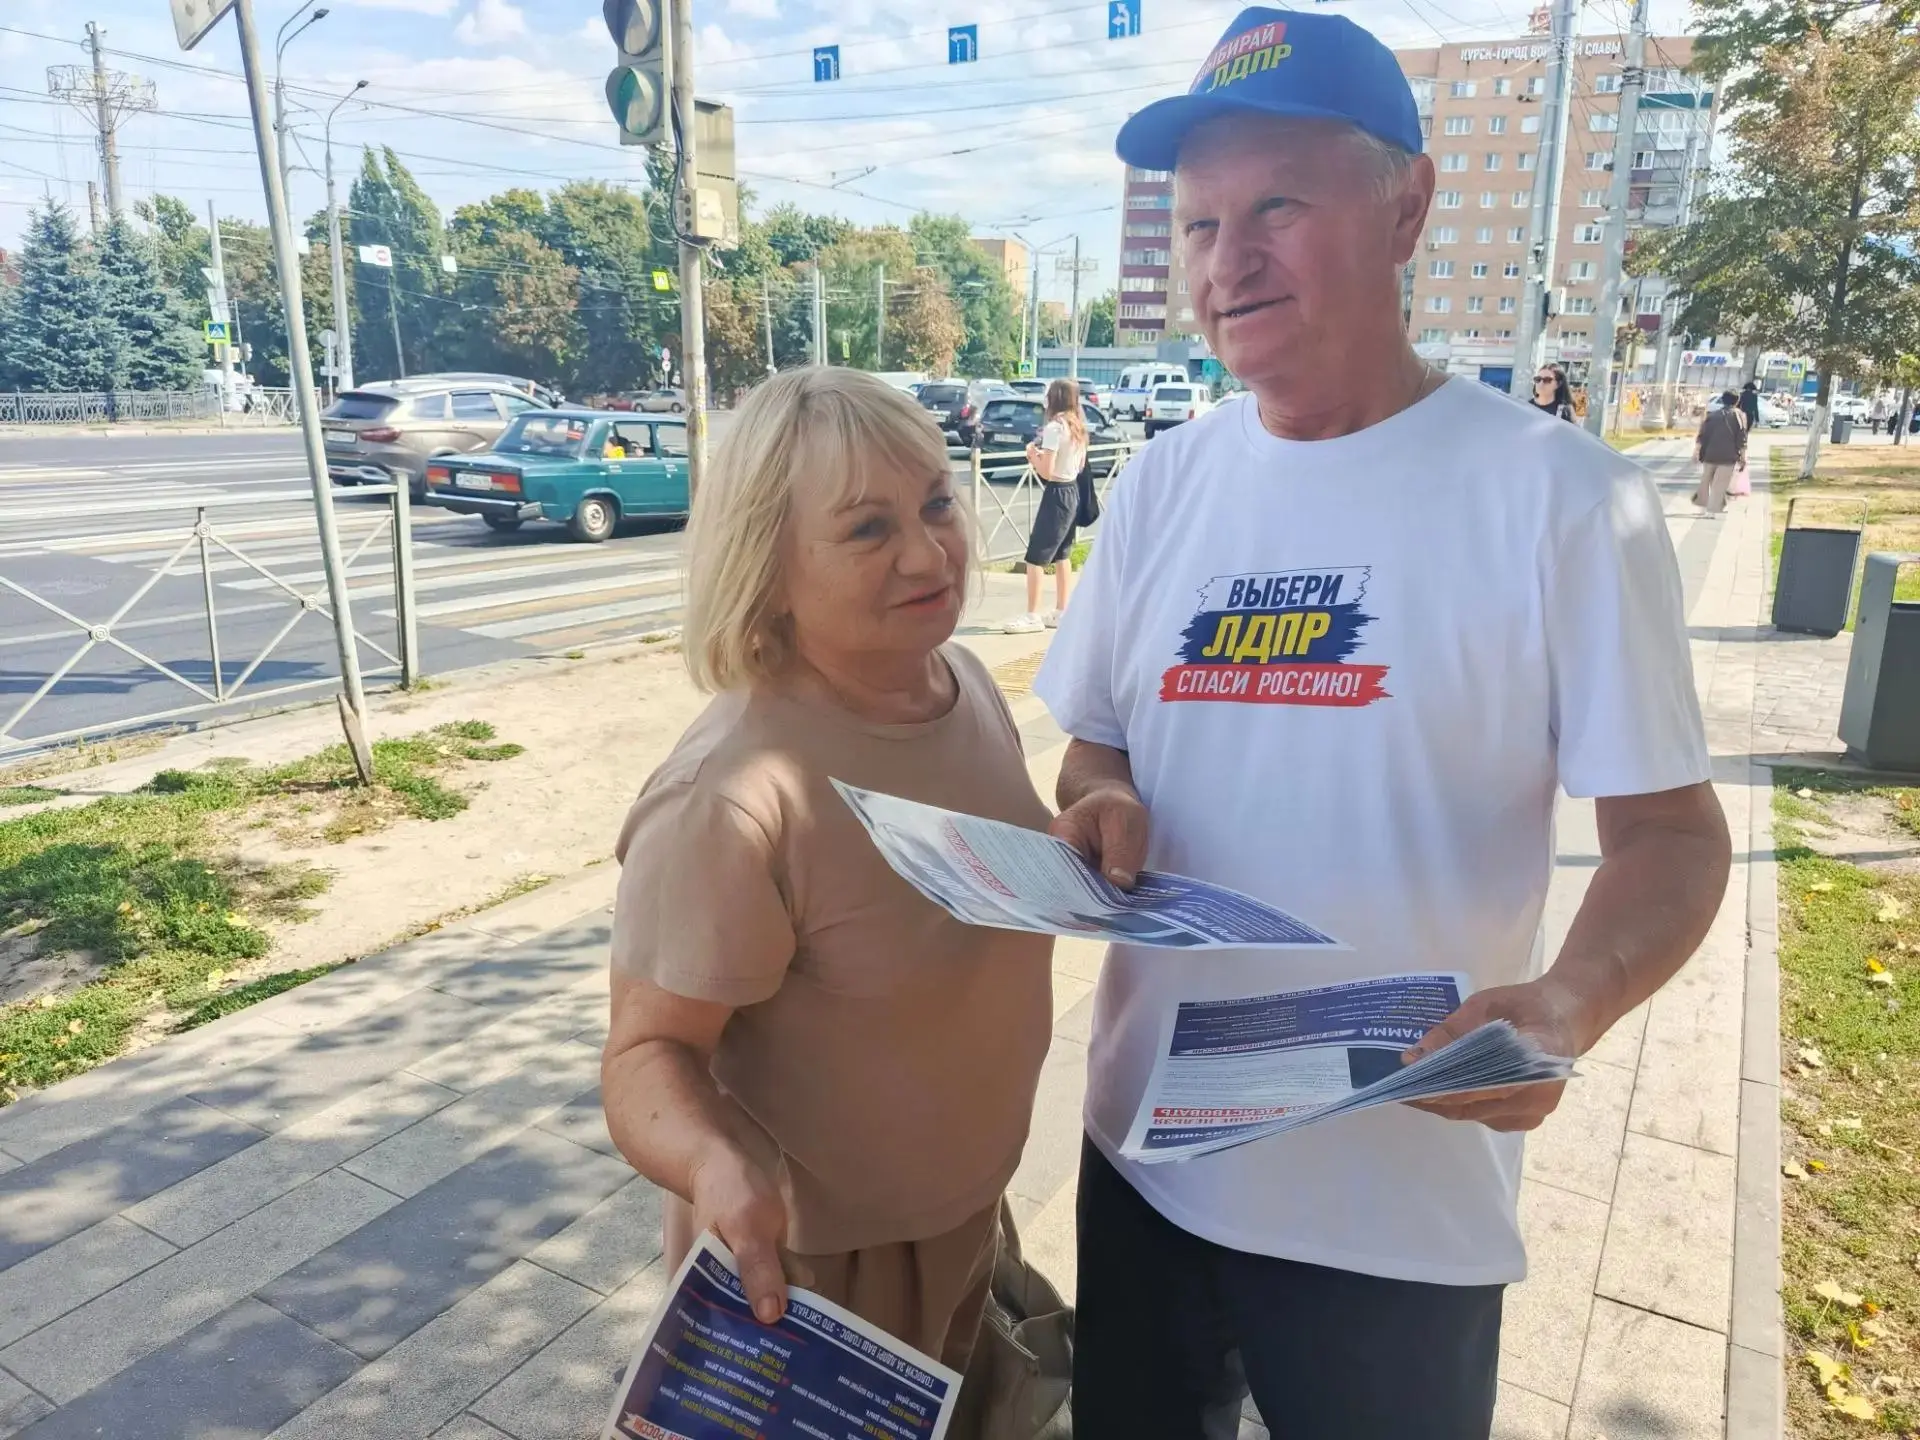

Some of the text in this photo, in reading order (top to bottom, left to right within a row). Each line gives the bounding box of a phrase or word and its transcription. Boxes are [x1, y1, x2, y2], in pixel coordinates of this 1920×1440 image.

[1206, 44, 1293, 94] ЛДПР
[1227, 575, 1344, 608] ВЫБЕРИ
[1202, 612, 1331, 664] ЛДПР
[1176, 670, 1362, 697] СПАСИ РОССИЮ!
[1362, 1027, 1423, 1039] РАММА
[819, 1316, 837, 1332] ЭТО
[838, 1326, 863, 1347] ГОЛОС
[859, 1339, 878, 1356] ВАШ
[894, 1358, 906, 1372] ЗА
